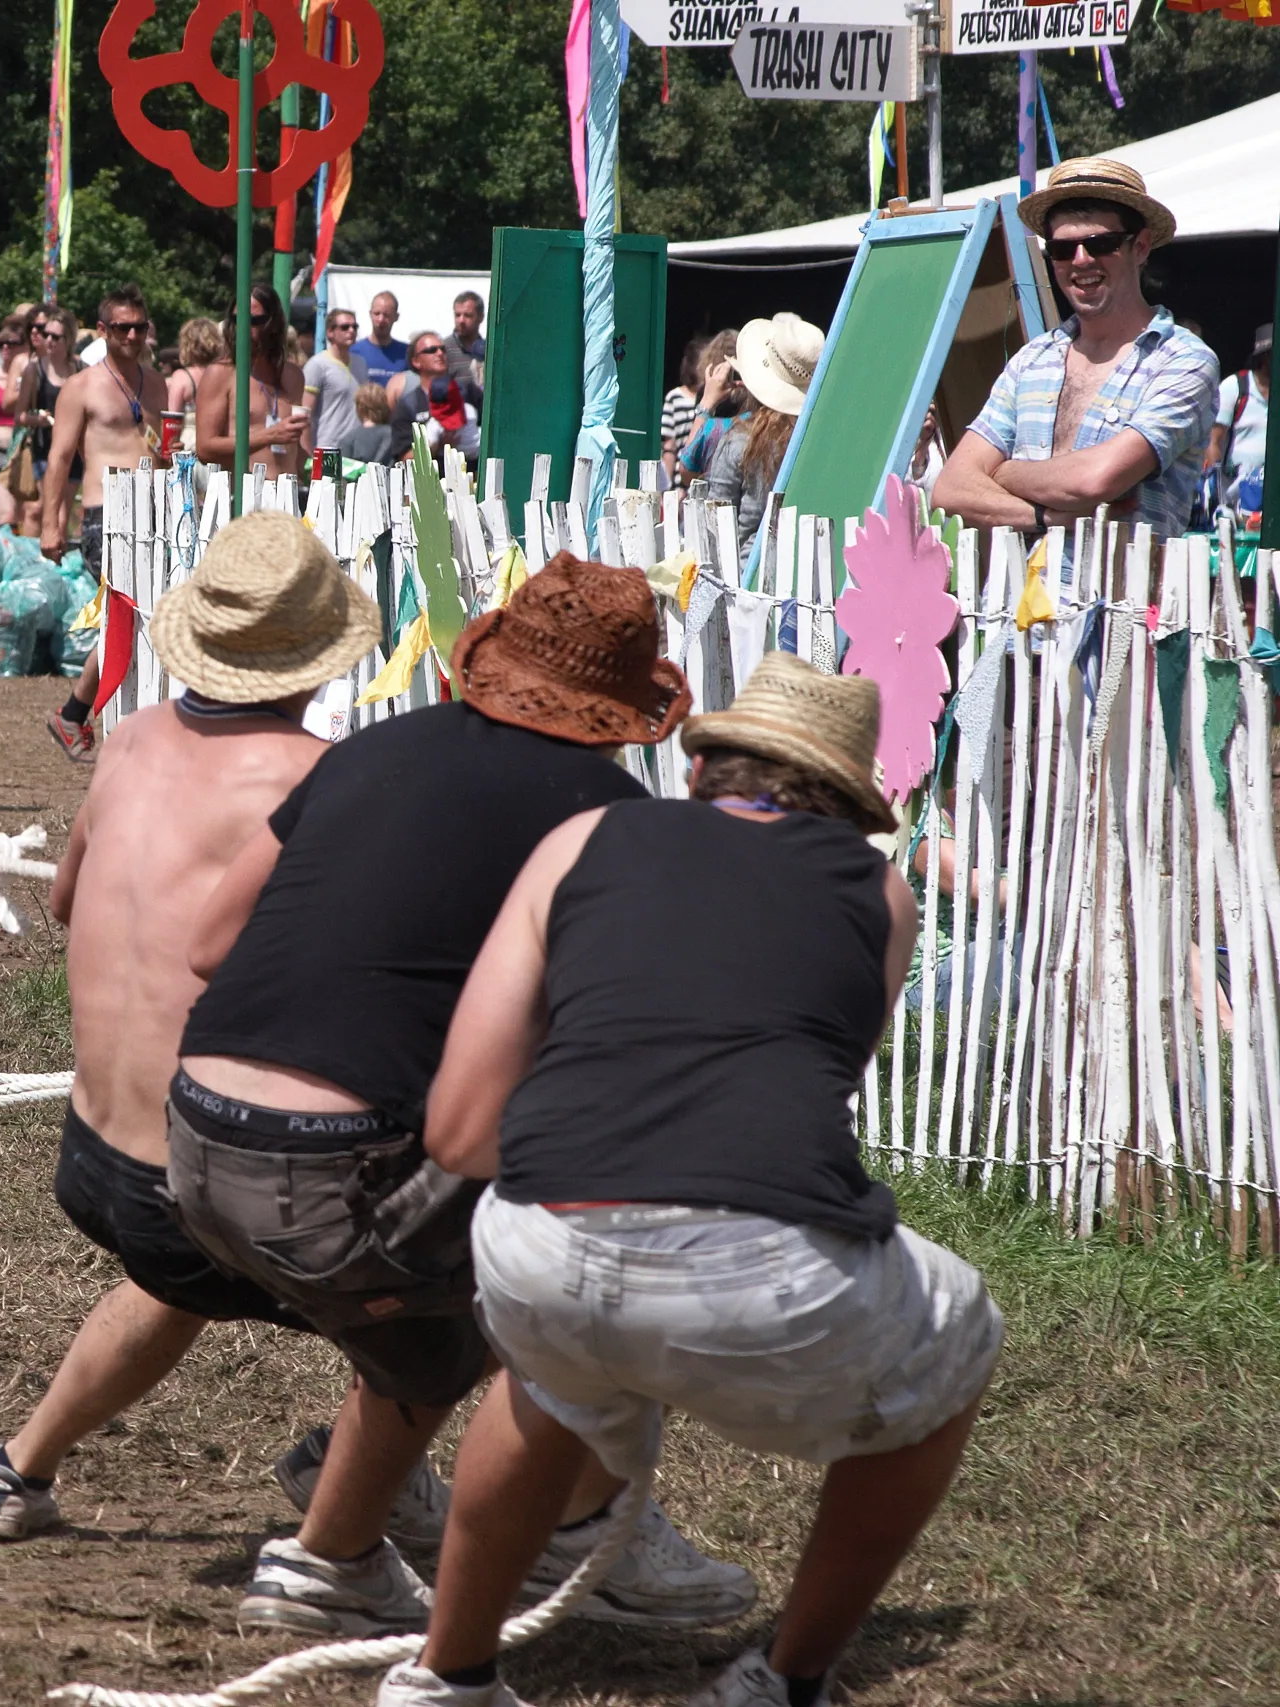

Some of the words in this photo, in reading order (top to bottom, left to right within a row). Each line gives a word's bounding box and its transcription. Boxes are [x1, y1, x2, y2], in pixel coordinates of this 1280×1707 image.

[959, 7, 1041, 45] PEDESTRIAN
[1043, 4, 1086, 39] GATES
[750, 27, 824, 90] TRASH
[830, 29, 893, 92] CITY
